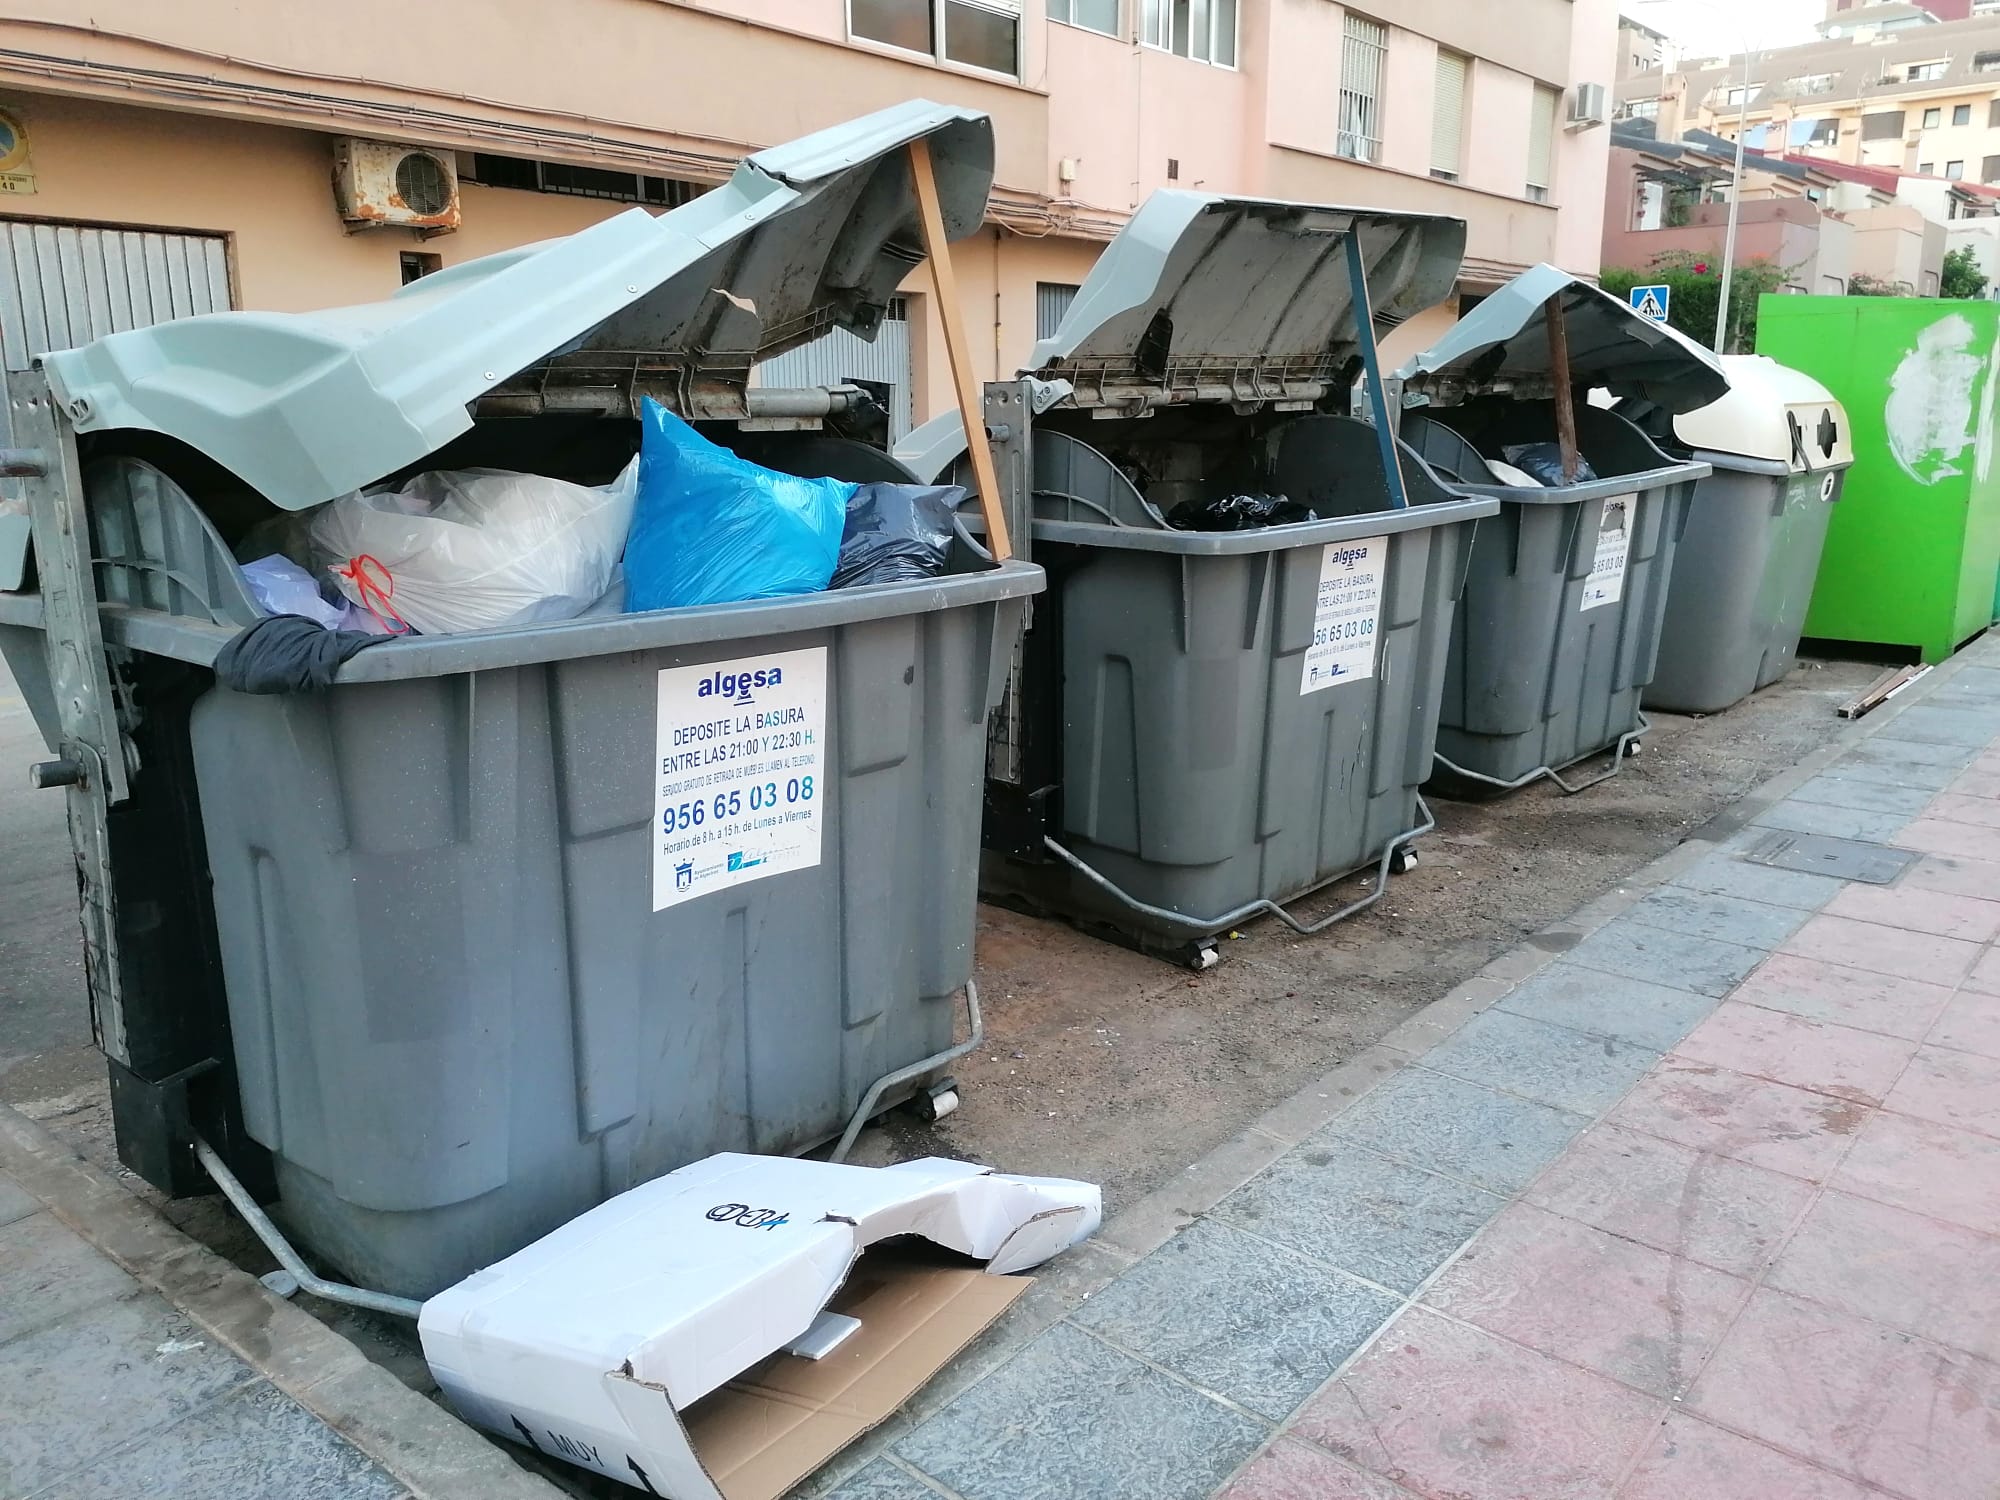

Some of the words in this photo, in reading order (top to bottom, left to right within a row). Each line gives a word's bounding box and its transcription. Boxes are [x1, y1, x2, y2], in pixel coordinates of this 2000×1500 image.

[1332, 547, 1367, 565] algesa
[1314, 626, 1327, 646] 56
[1329, 624, 1342, 642] 65
[1344, 621, 1358, 639] 03
[1360, 618, 1374, 636] 08
[698, 667, 782, 698] algesa
[674, 719, 731, 747] DEPOSITE
[736, 716, 751, 733] LA
[756, 706, 805, 730] BASURA
[663, 750, 701, 775] ENTRE
[704, 744, 727, 766] LAS
[729, 738, 759, 762] 21:00
[762, 736, 770, 753] Y
[772, 730, 801, 751] 22:30
[804, 729, 816, 746] H.
[706, 774, 713, 786] DE
[736, 767, 743, 779] DE
[663, 799, 705, 834] 956
[713, 789, 741, 819] 65
[750, 783, 777, 811] 03
[786, 775, 814, 803] 08
[663, 837, 691, 856] Horario
[691, 833, 701, 847] de
[702, 831, 707, 844] 8
[708, 829, 716, 841] h.
[717, 829, 722, 840] a
[724, 824, 733, 837] 15
[734, 822, 741, 834] h.
[743, 820, 752, 833] de
[753, 815, 777, 830] Lunes
[778, 814, 783, 825] a
[785, 809, 812, 823] Viernes
[547, 1430, 605, 1468] MUY
